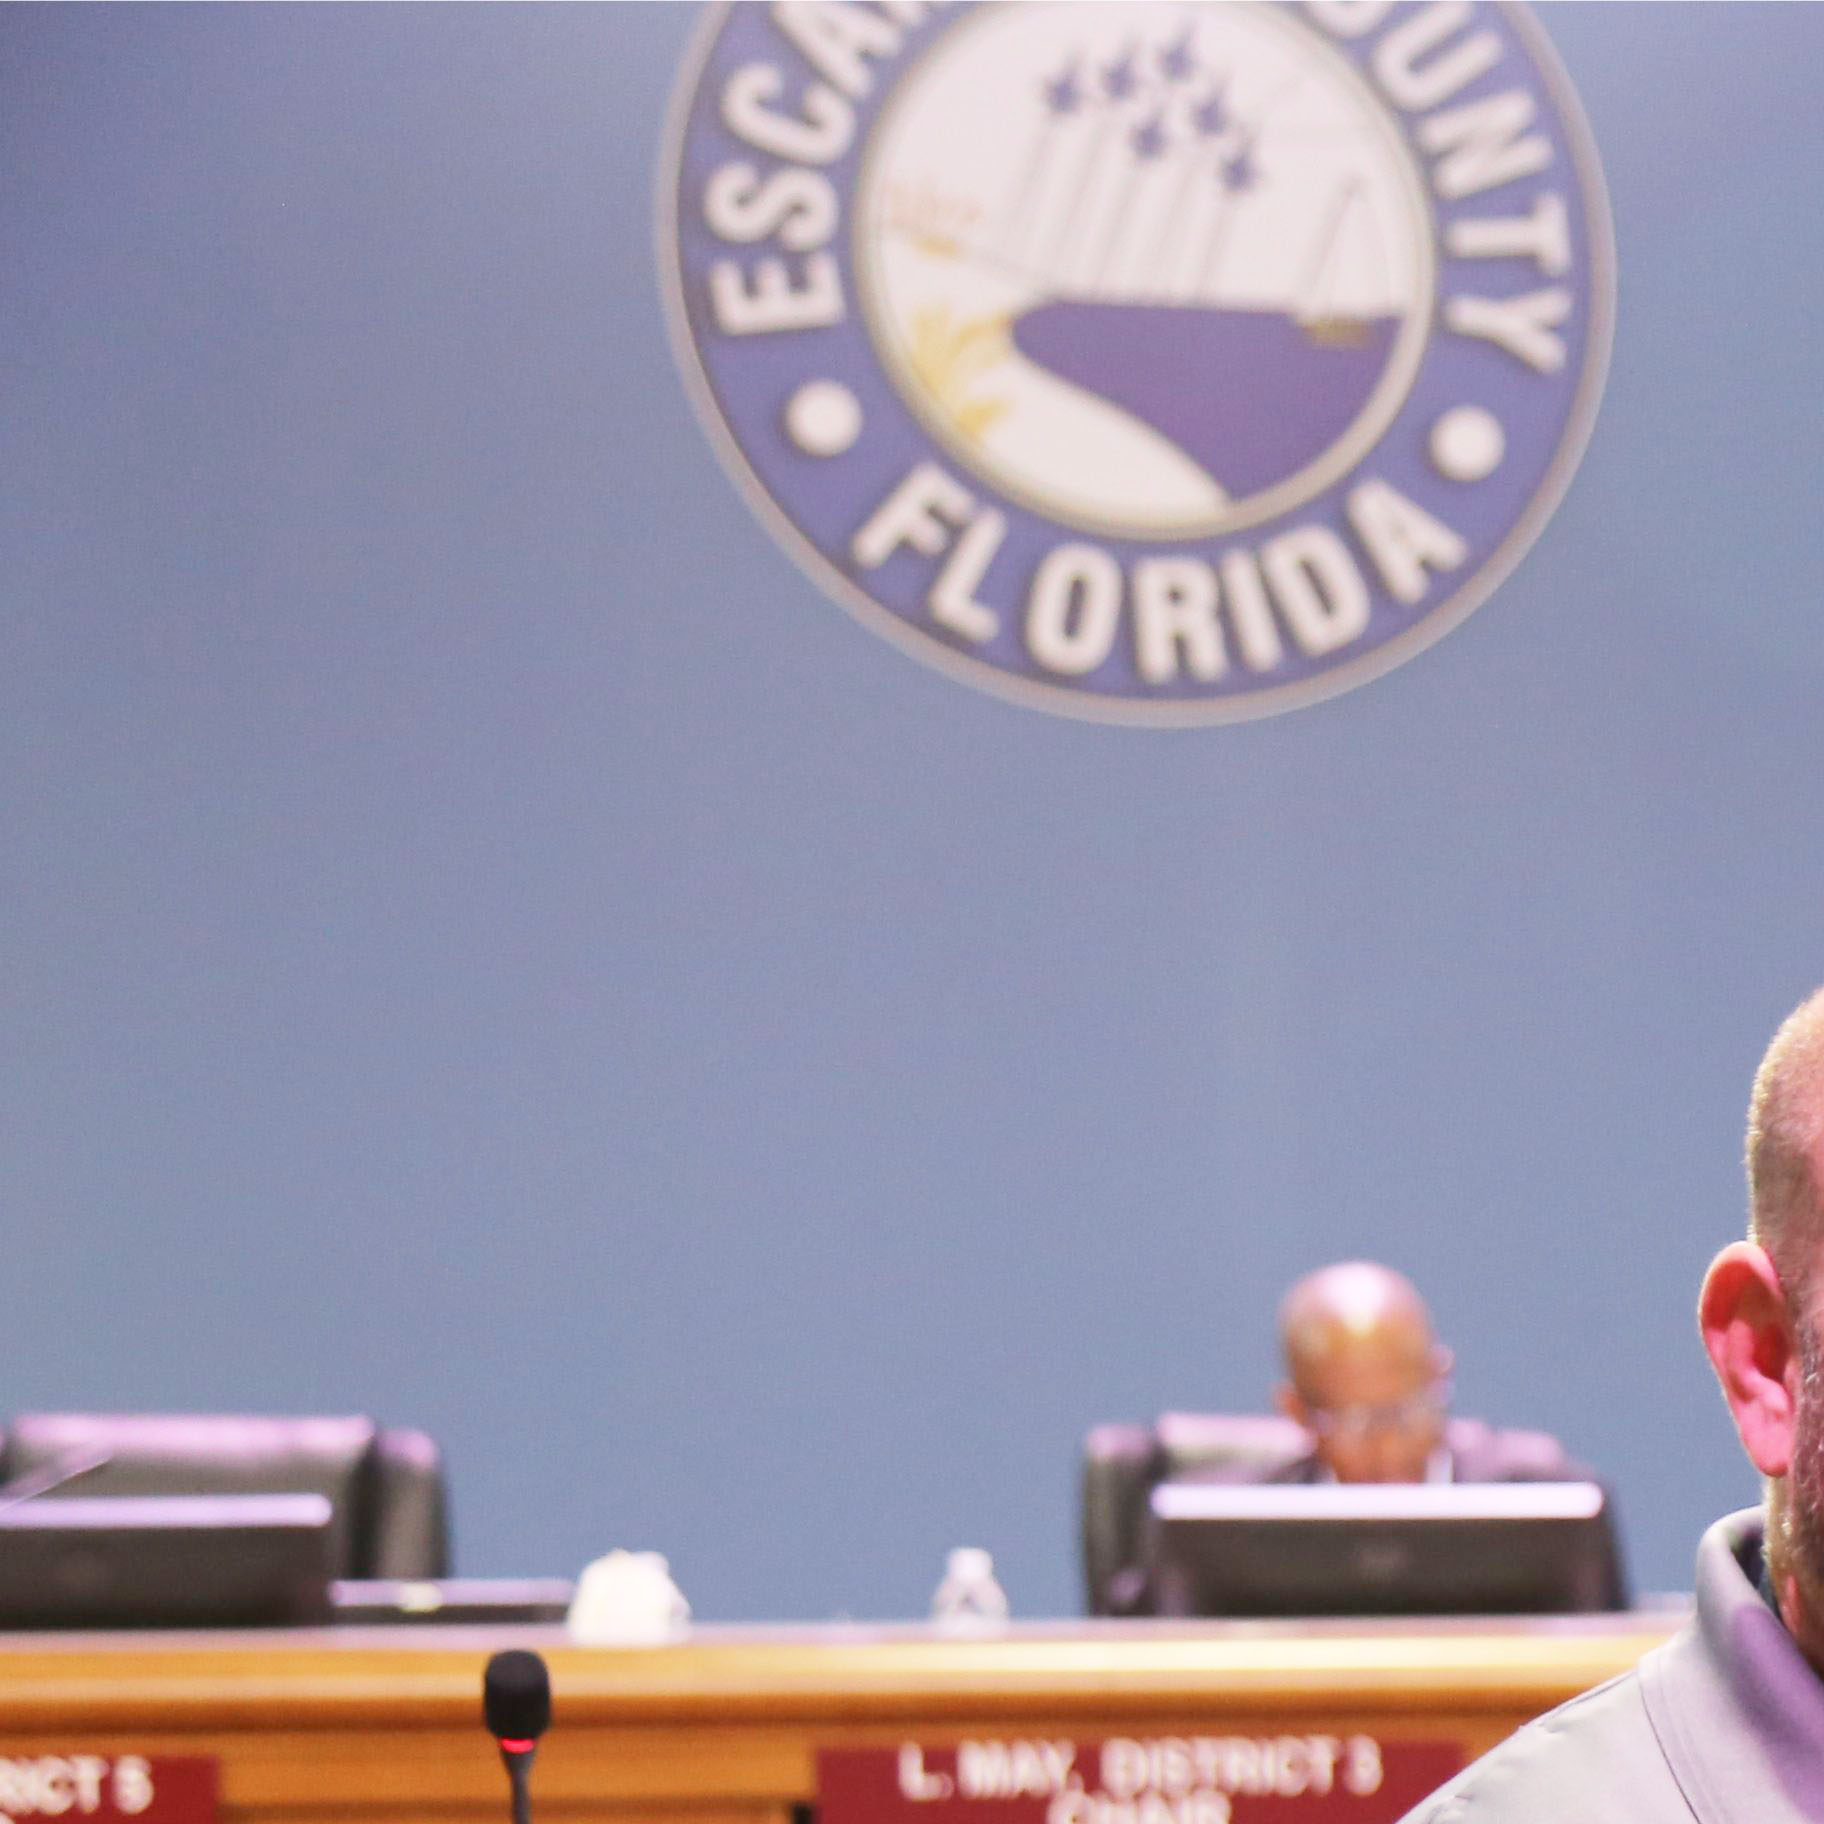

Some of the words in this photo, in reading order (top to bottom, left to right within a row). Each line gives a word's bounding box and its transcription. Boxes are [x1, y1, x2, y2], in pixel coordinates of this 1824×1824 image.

[852, 461, 1470, 686] FLORIDA
[900, 1741, 952, 1801] L.
[1101, 1736, 1343, 1799] DISTRICT
